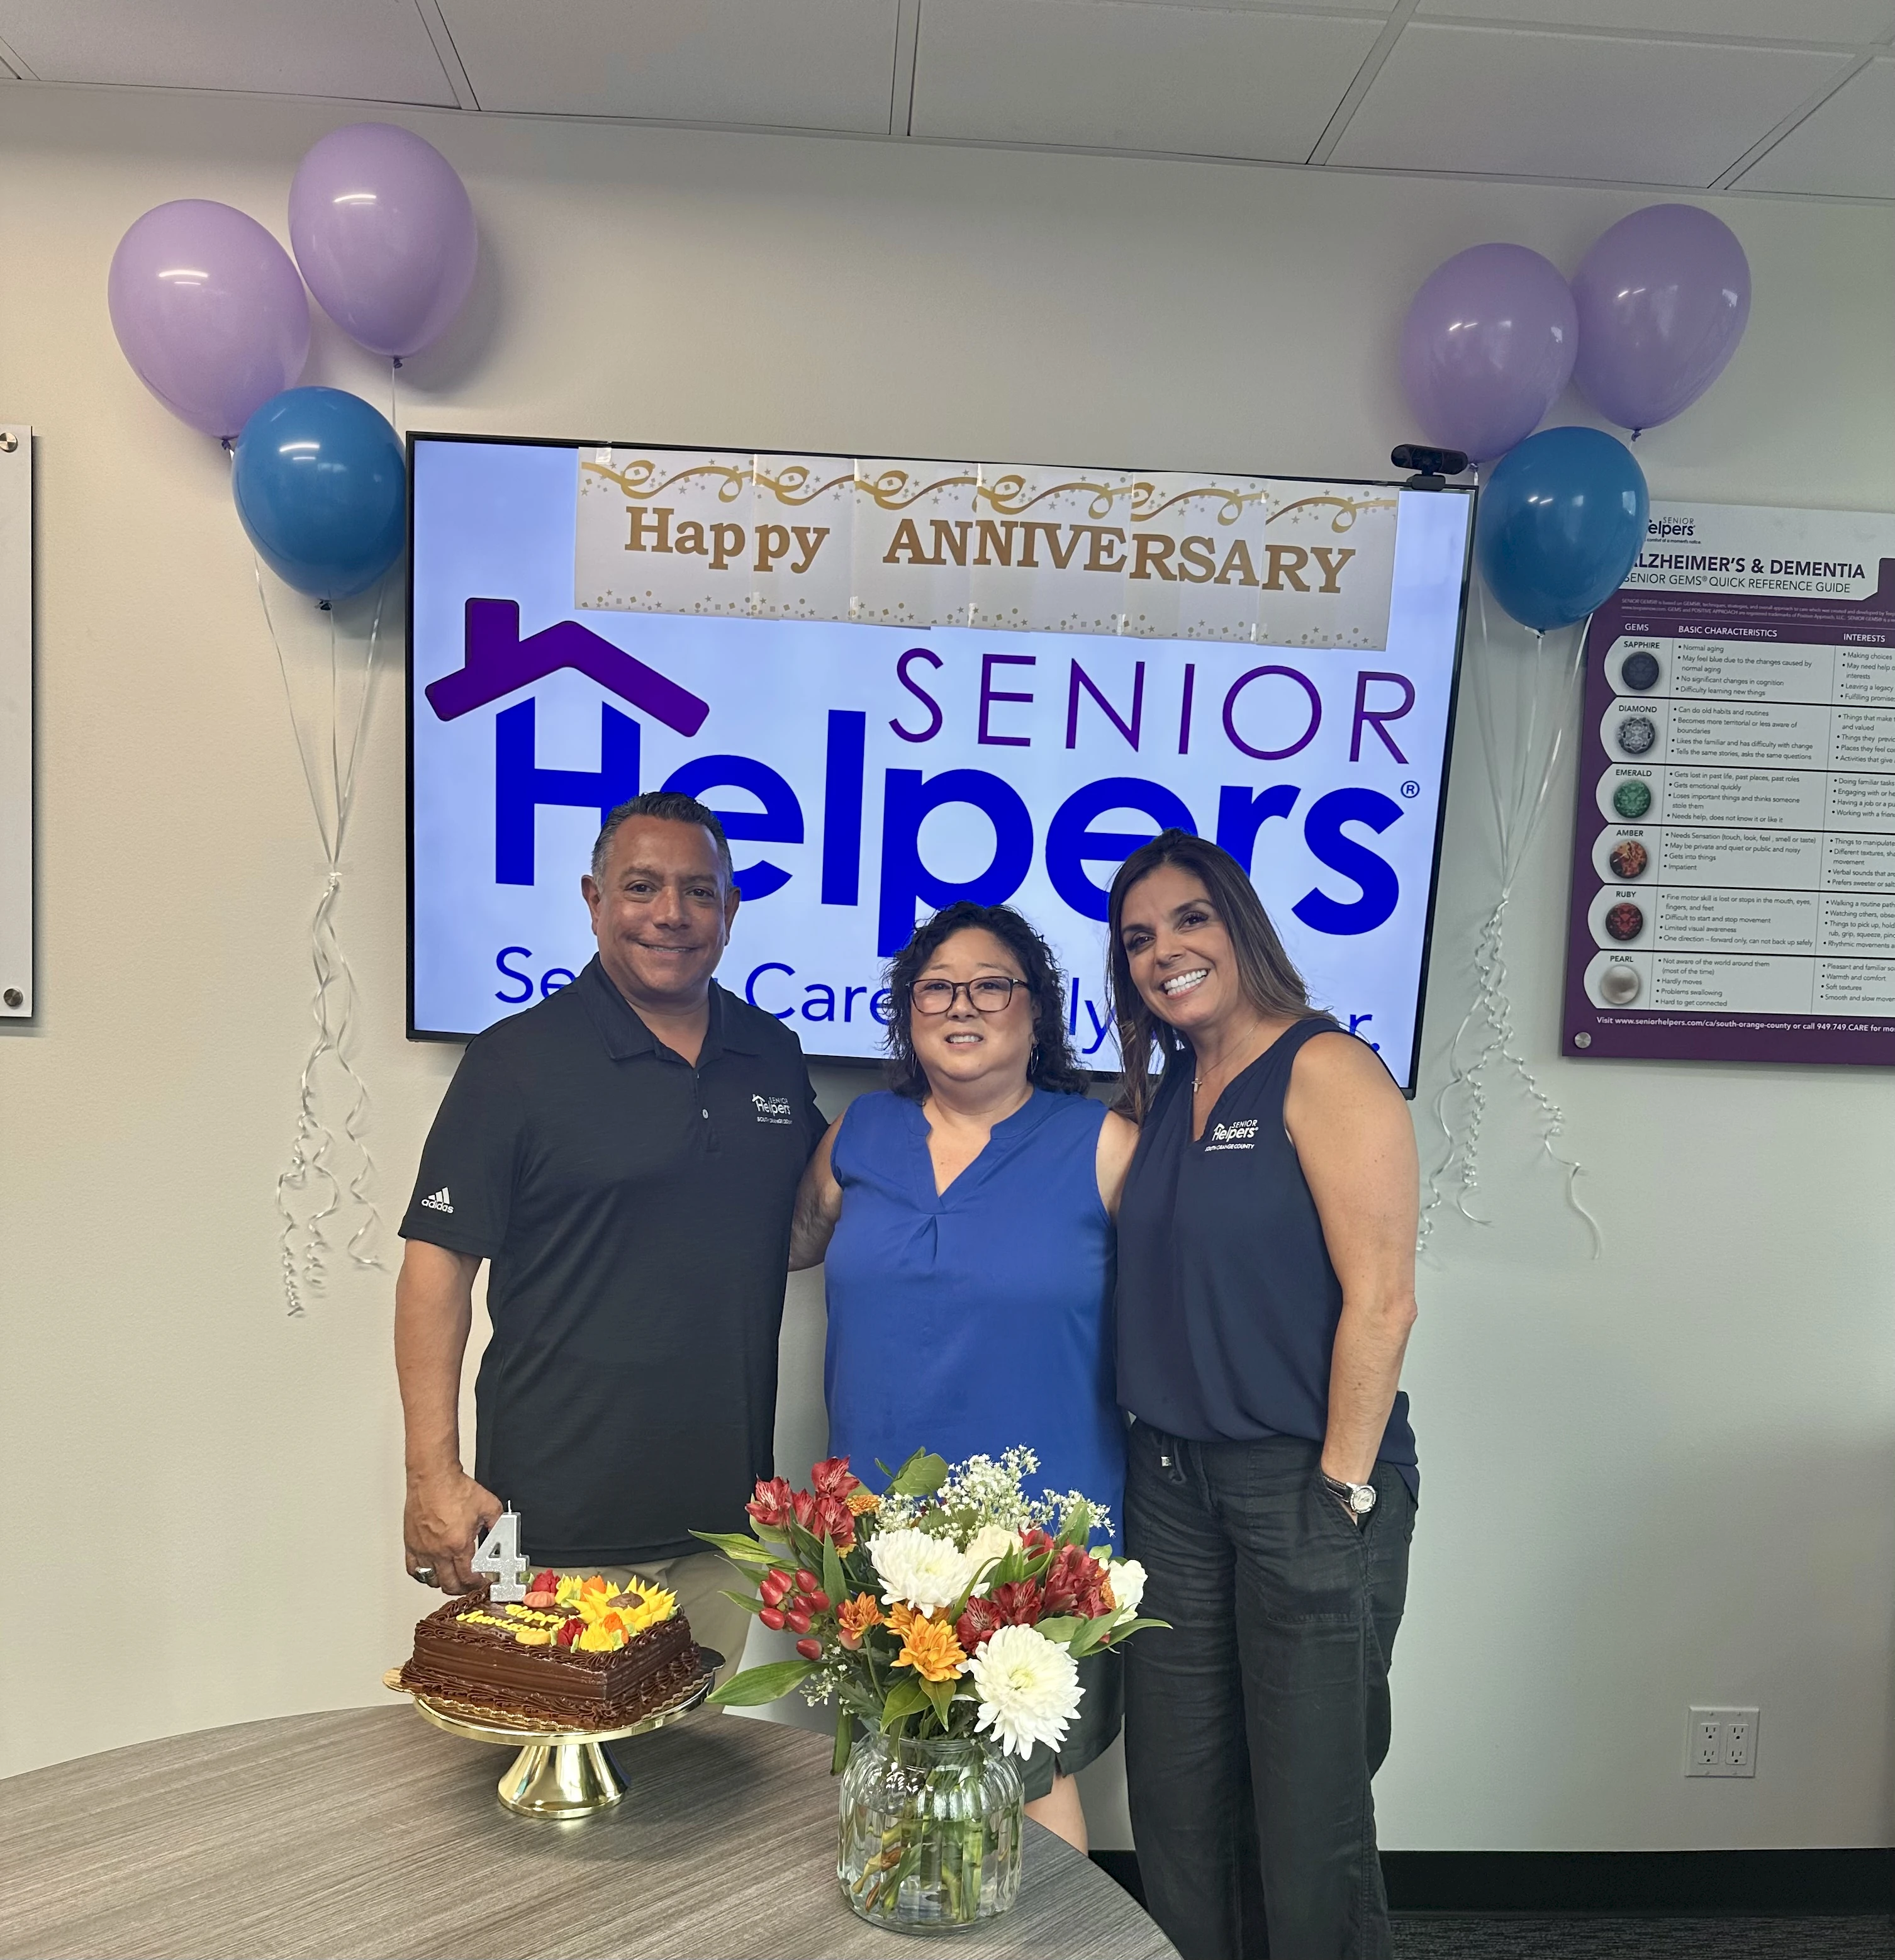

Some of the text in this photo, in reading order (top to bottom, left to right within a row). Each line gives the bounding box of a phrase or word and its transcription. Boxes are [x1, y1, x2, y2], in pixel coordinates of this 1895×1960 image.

[1663, 517, 1694, 525] SENIOR
[1648, 521, 1694, 537] elpers
[624, 506, 1356, 594] Happy ANNIVERSARY
[1634, 553, 1865, 579] LZHEIMER'S & DEMENTIA
[1709, 576, 1745, 587] QUICK
[1748, 578, 1812, 591] REFERENCE
[1816, 583, 1851, 593] GUIDE
[1624, 623, 1648, 631] GEMS
[1704, 627, 1777, 637] CHARACTERISTICS
[1843, 633, 1885, 642] INTERESTS
[1623, 641, 1660, 649] SAPPHIRE
[1682, 654, 1695, 663] May
[1756, 658, 1780, 666] changes
[1804, 659, 1811, 668] by
[1848, 651, 1869, 660] Making
[1847, 662, 1859, 670] May
[1877, 664, 1890, 672] help
[1723, 677, 1748, 685] changes
[1680, 685, 1706, 695] Difficulty
[1708, 686, 1731, 695] learning
[1747, 688, 1765, 697] things
[1845, 682, 1867, 692] Leaving
[1875, 684, 1893, 693] legacy
[889, 647, 1416, 764] SENIOR
[1722, 793, 1740, 802] things
[1670, 842, 1682, 850] May
[1753, 845, 1770, 853] public
[1697, 853, 1716, 861] things
[1615, 1017, 1791, 1030] www.seniorhelpers.com/ca/south-orange-county
[1817, 1022, 1869, 1031] 949.749.CARE
[755, 1100, 791, 1117] Helpers
[1233, 1119, 1258, 1129] SENIOR
[1212, 1126, 1256, 1142] Helpers
[421, 1199, 454, 1214] adidas
[471, 1511, 530, 1602] 4
